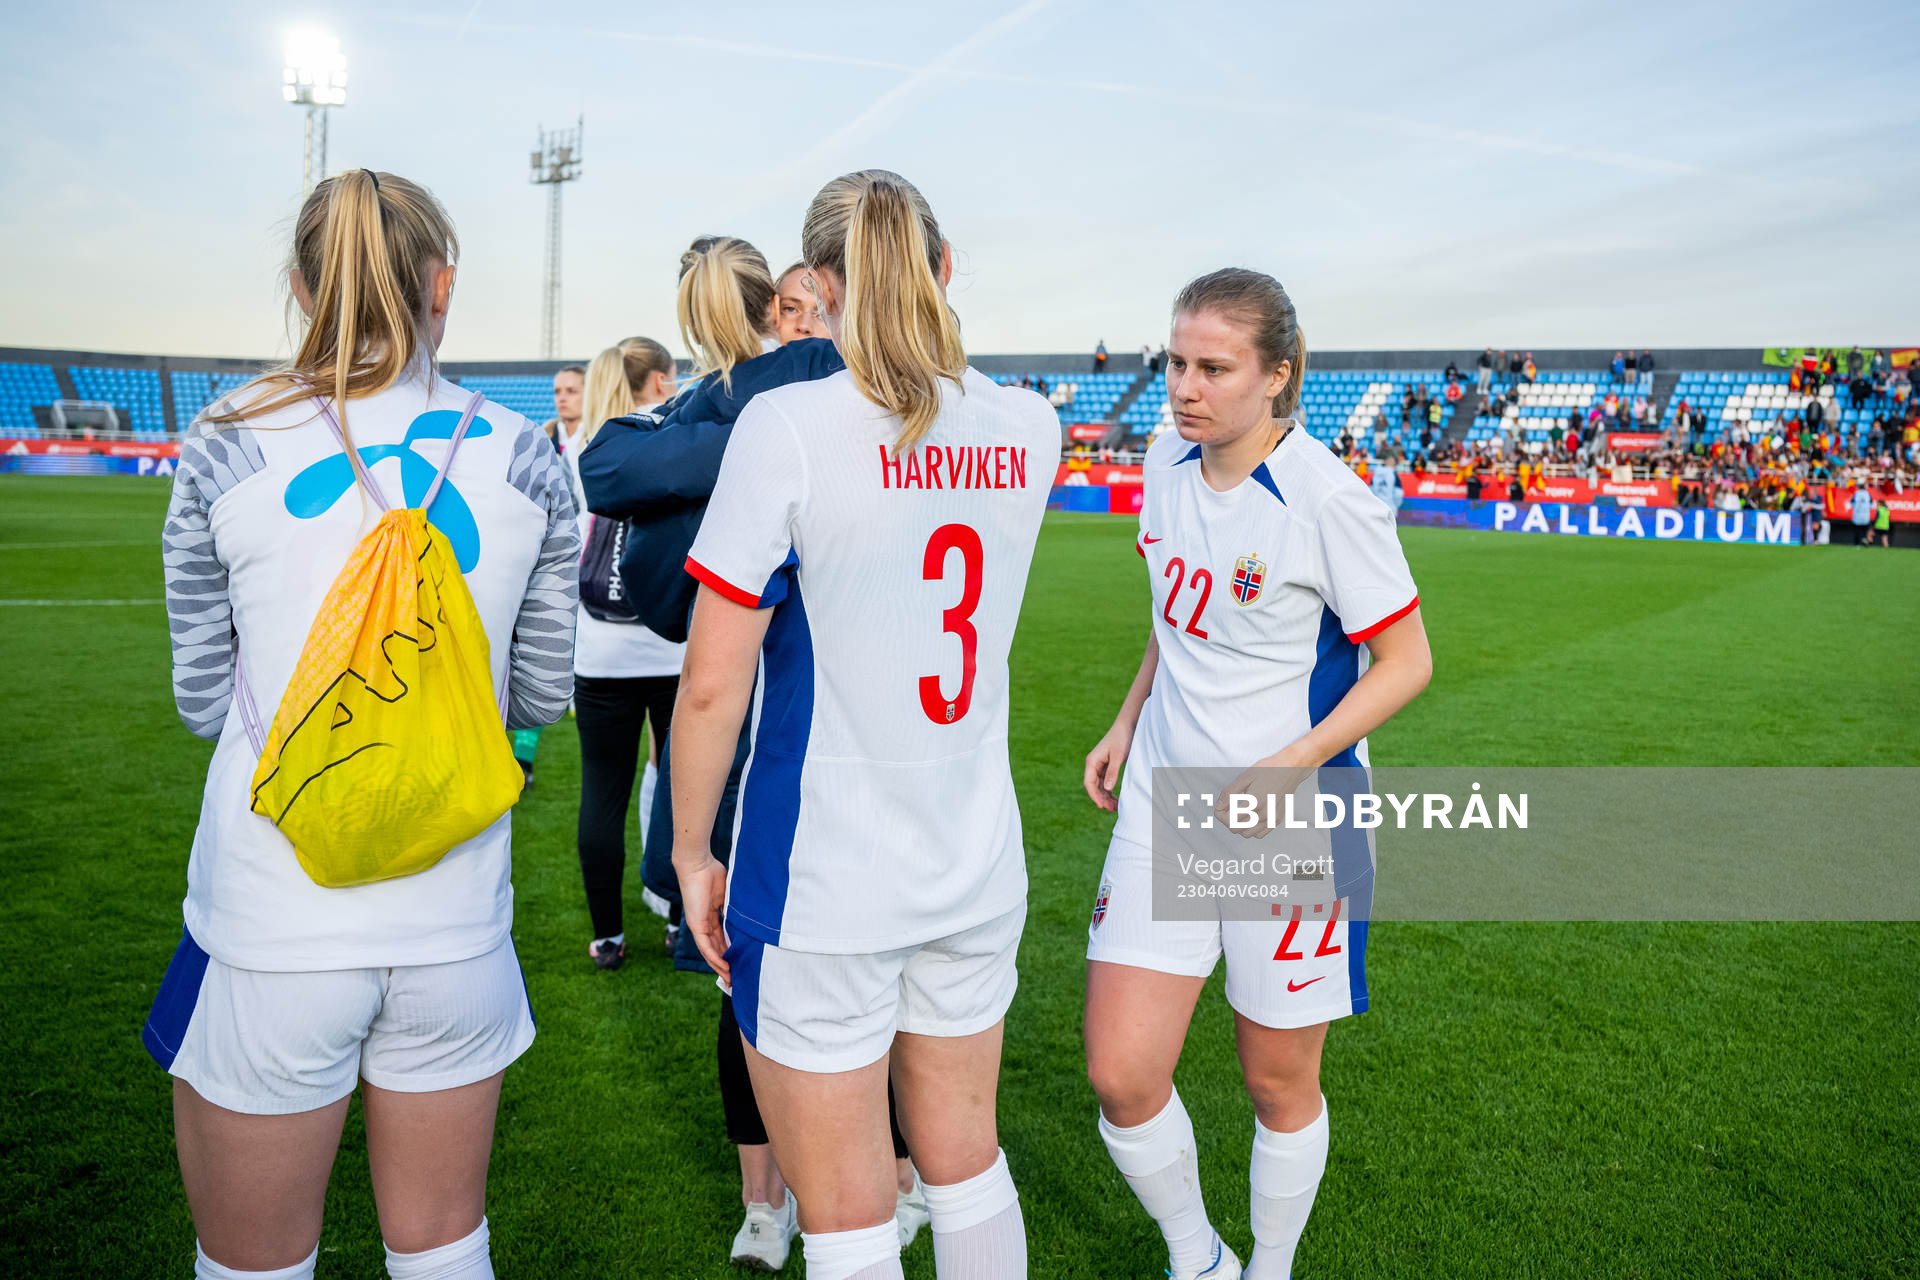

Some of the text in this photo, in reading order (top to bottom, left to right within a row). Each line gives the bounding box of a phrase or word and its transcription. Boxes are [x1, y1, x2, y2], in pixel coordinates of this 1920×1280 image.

[879, 444, 1026, 489] HARVIKEN
[1494, 502, 1792, 545] PALLADIUM
[918, 523, 984, 725] 3
[1163, 556, 1213, 640] 22
[1271, 899, 1342, 961] 22
